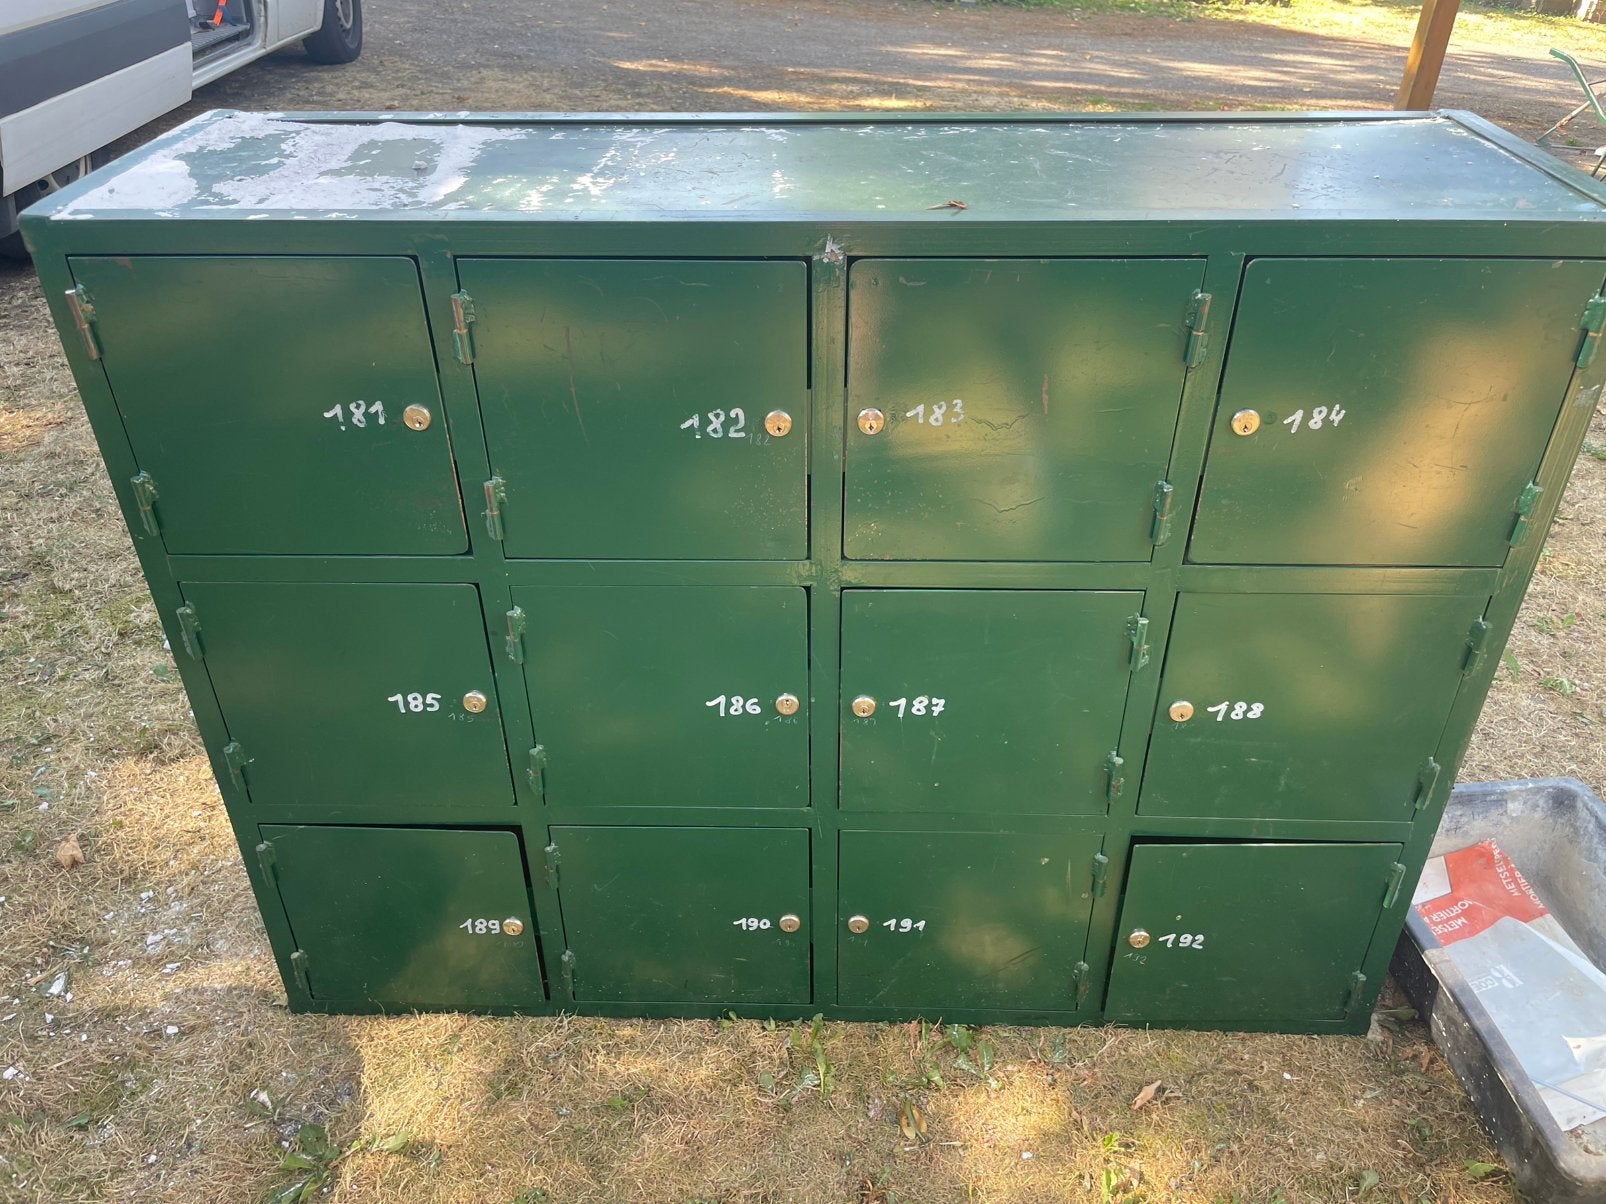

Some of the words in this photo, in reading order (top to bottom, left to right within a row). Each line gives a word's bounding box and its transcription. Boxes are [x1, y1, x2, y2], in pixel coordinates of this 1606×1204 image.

[323, 400, 386, 431] 181
[679, 407, 746, 439] 182
[905, 399, 965, 427] 183
[1282, 403, 1346, 434] 184
[387, 692, 442, 714] 185
[705, 694, 762, 717] 186
[888, 695, 946, 720] 187
[1206, 700, 1265, 722] 188
[459, 918, 501, 934] 189
[732, 917, 771, 931] 190
[882, 918, 926, 933] 191
[1158, 933, 1205, 950] 192
